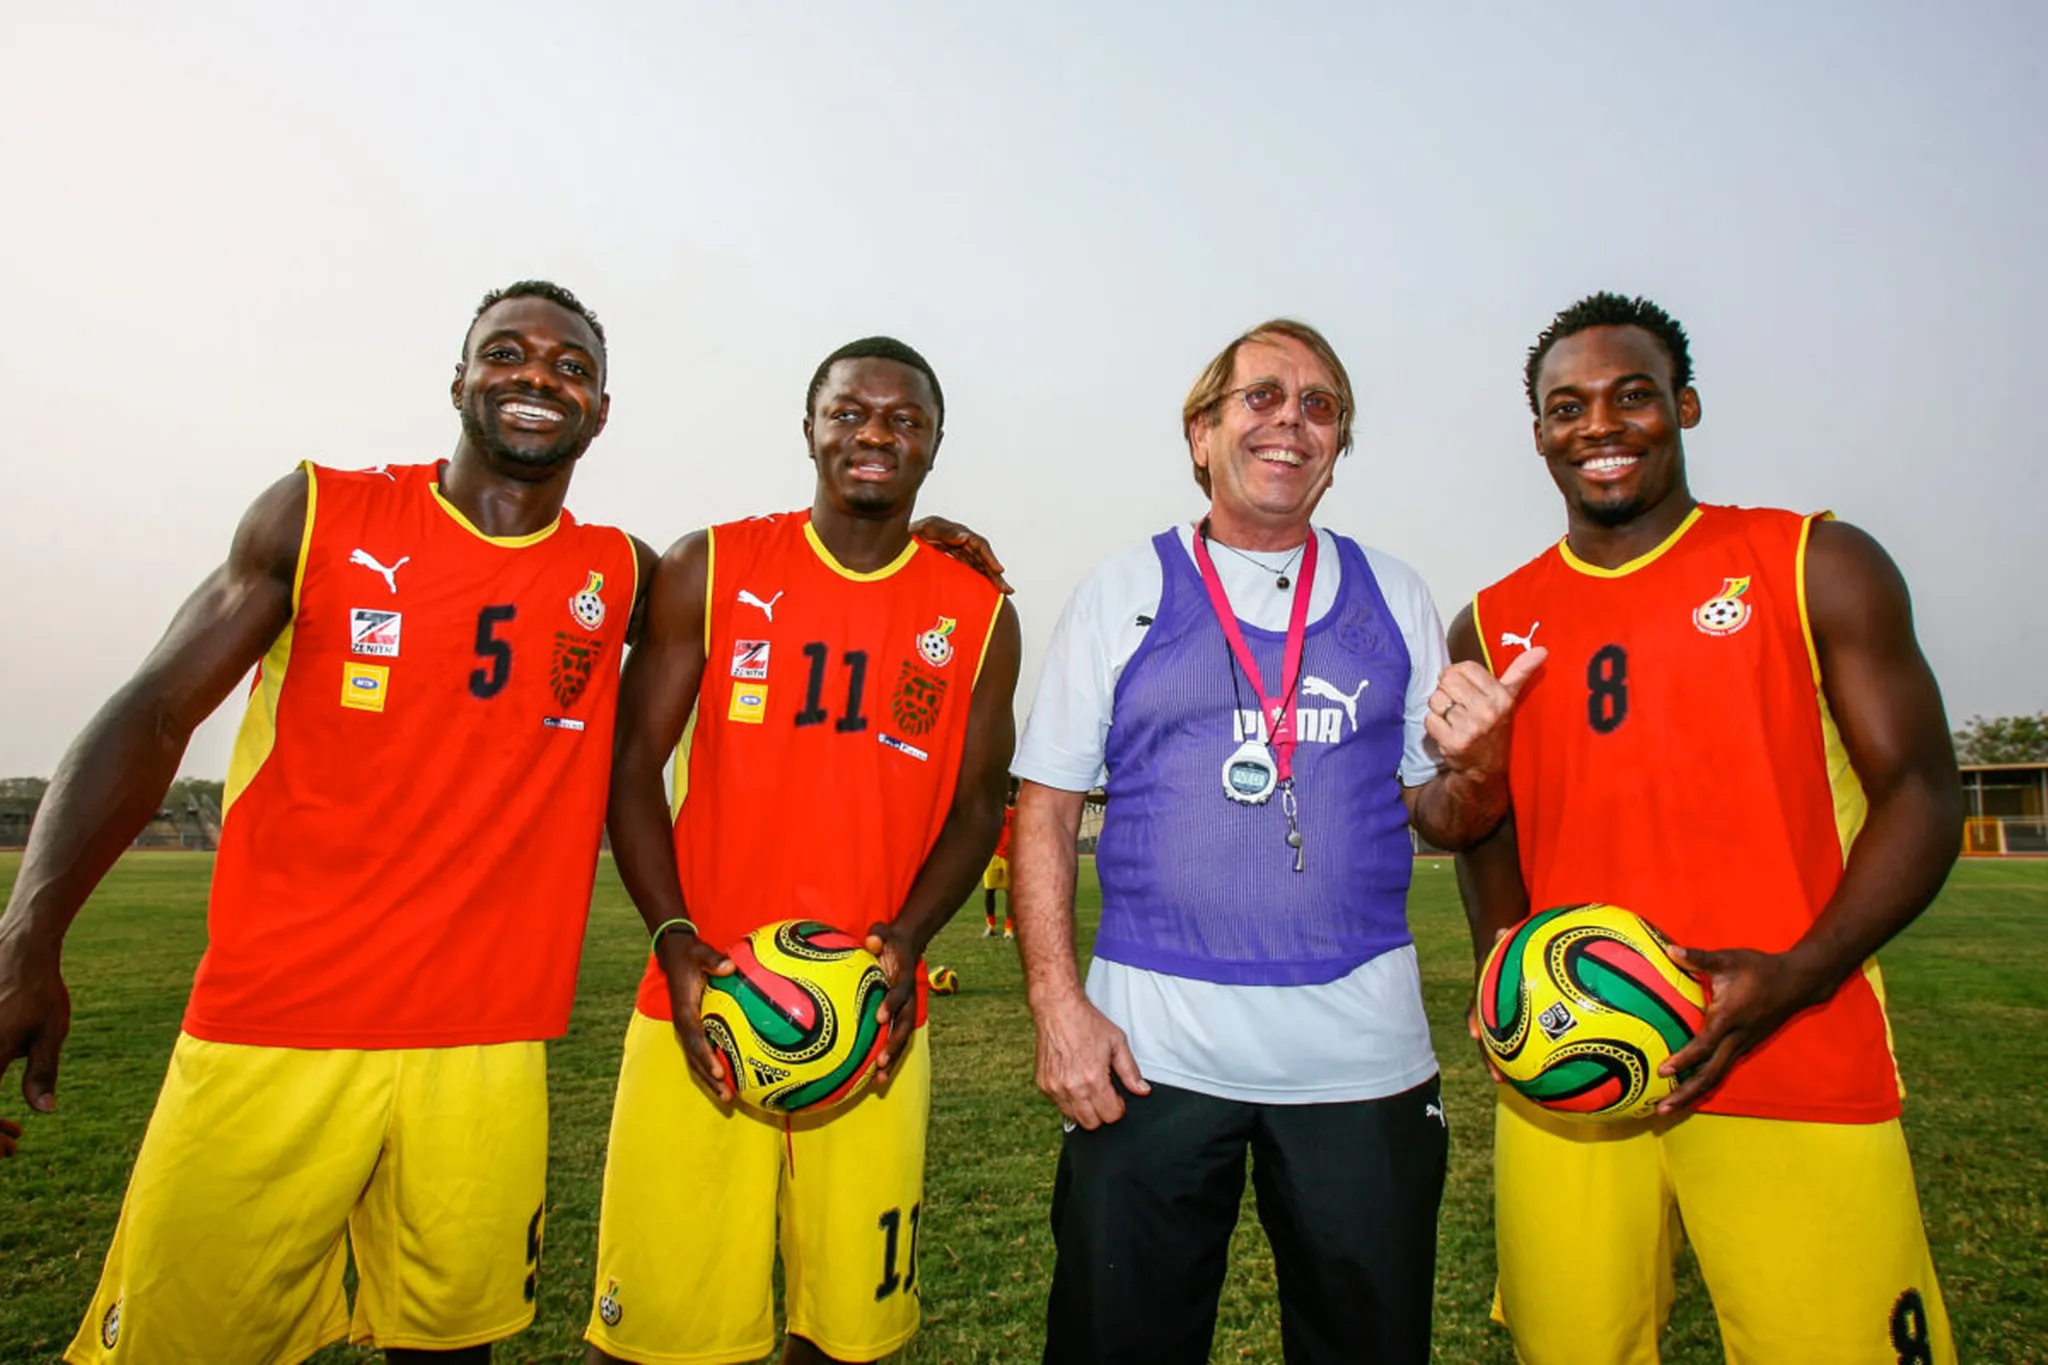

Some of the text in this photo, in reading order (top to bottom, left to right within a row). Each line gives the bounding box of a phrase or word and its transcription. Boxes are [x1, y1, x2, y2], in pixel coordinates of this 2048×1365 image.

[469, 604, 516, 699] 5
[795, 641, 868, 733] 11
[1587, 643, 1628, 735] 8
